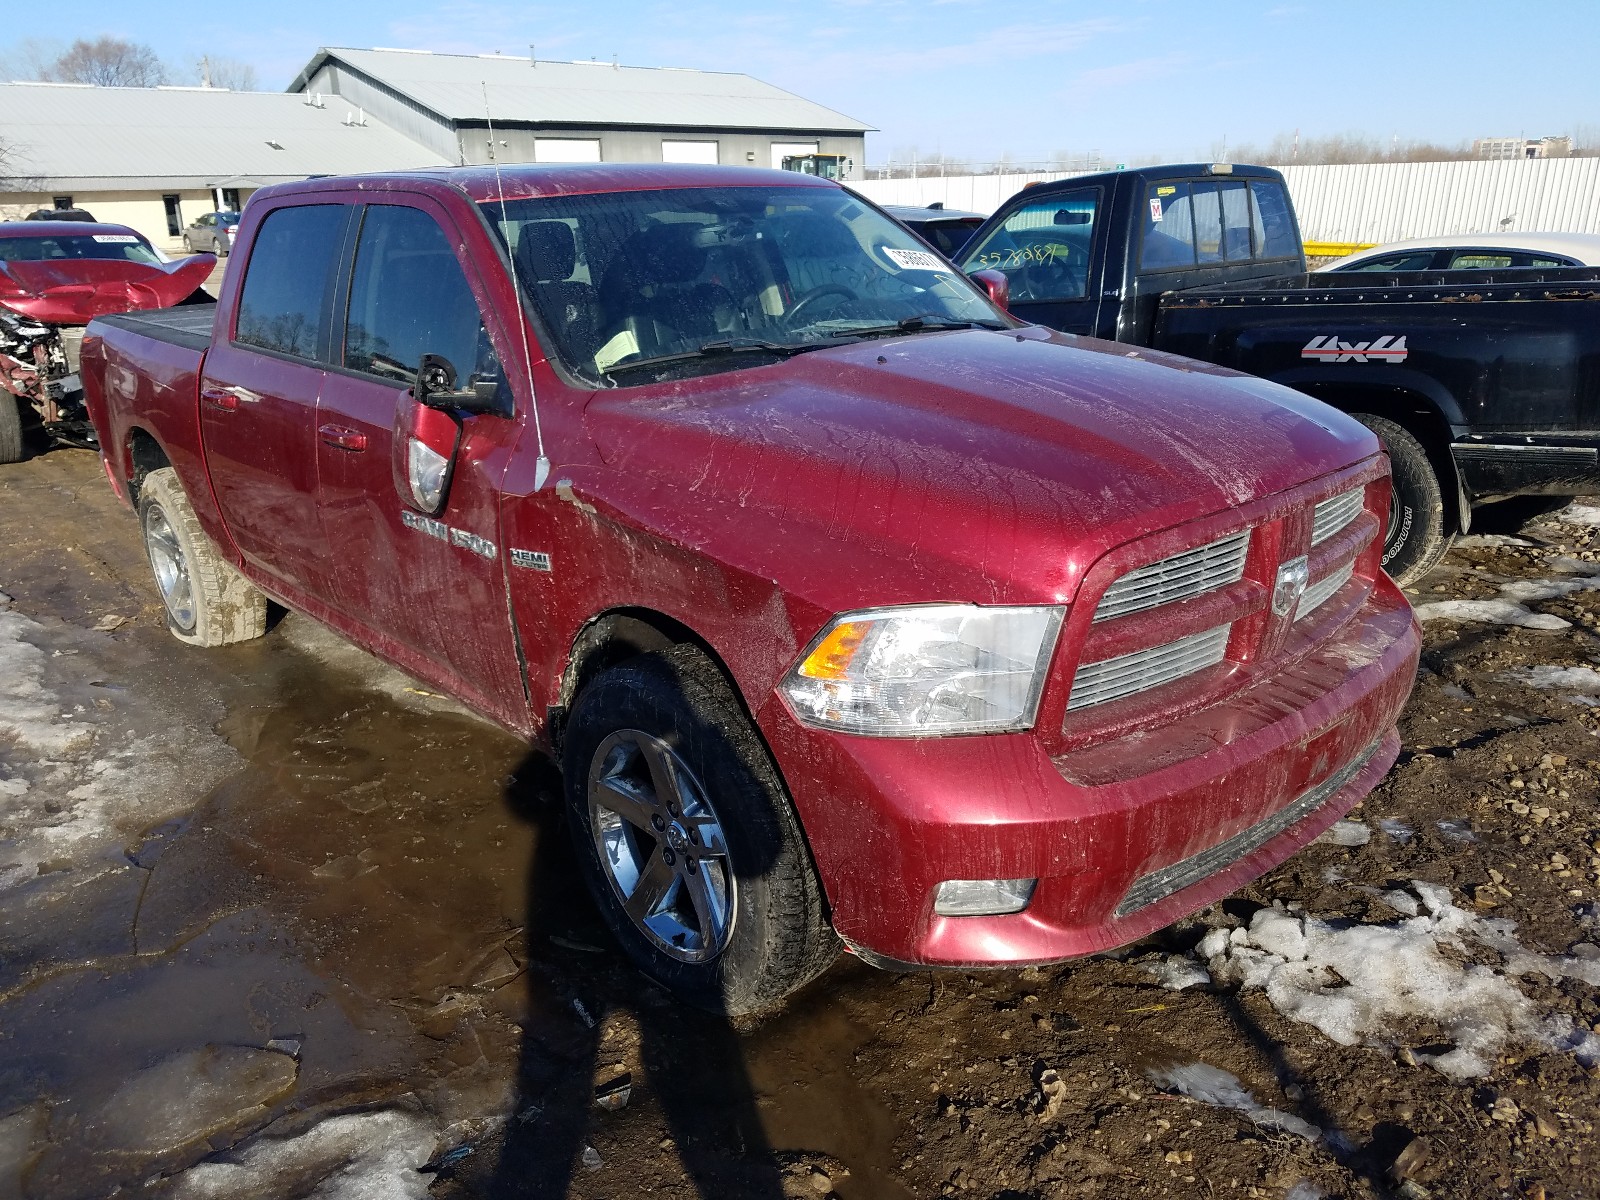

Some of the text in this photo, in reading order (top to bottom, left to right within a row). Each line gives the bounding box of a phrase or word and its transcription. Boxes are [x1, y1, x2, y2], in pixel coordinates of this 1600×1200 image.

[1301, 335, 1408, 363] 4x4
[401, 510, 497, 560] RAM 1500
[510, 549, 548, 563] HEMI
